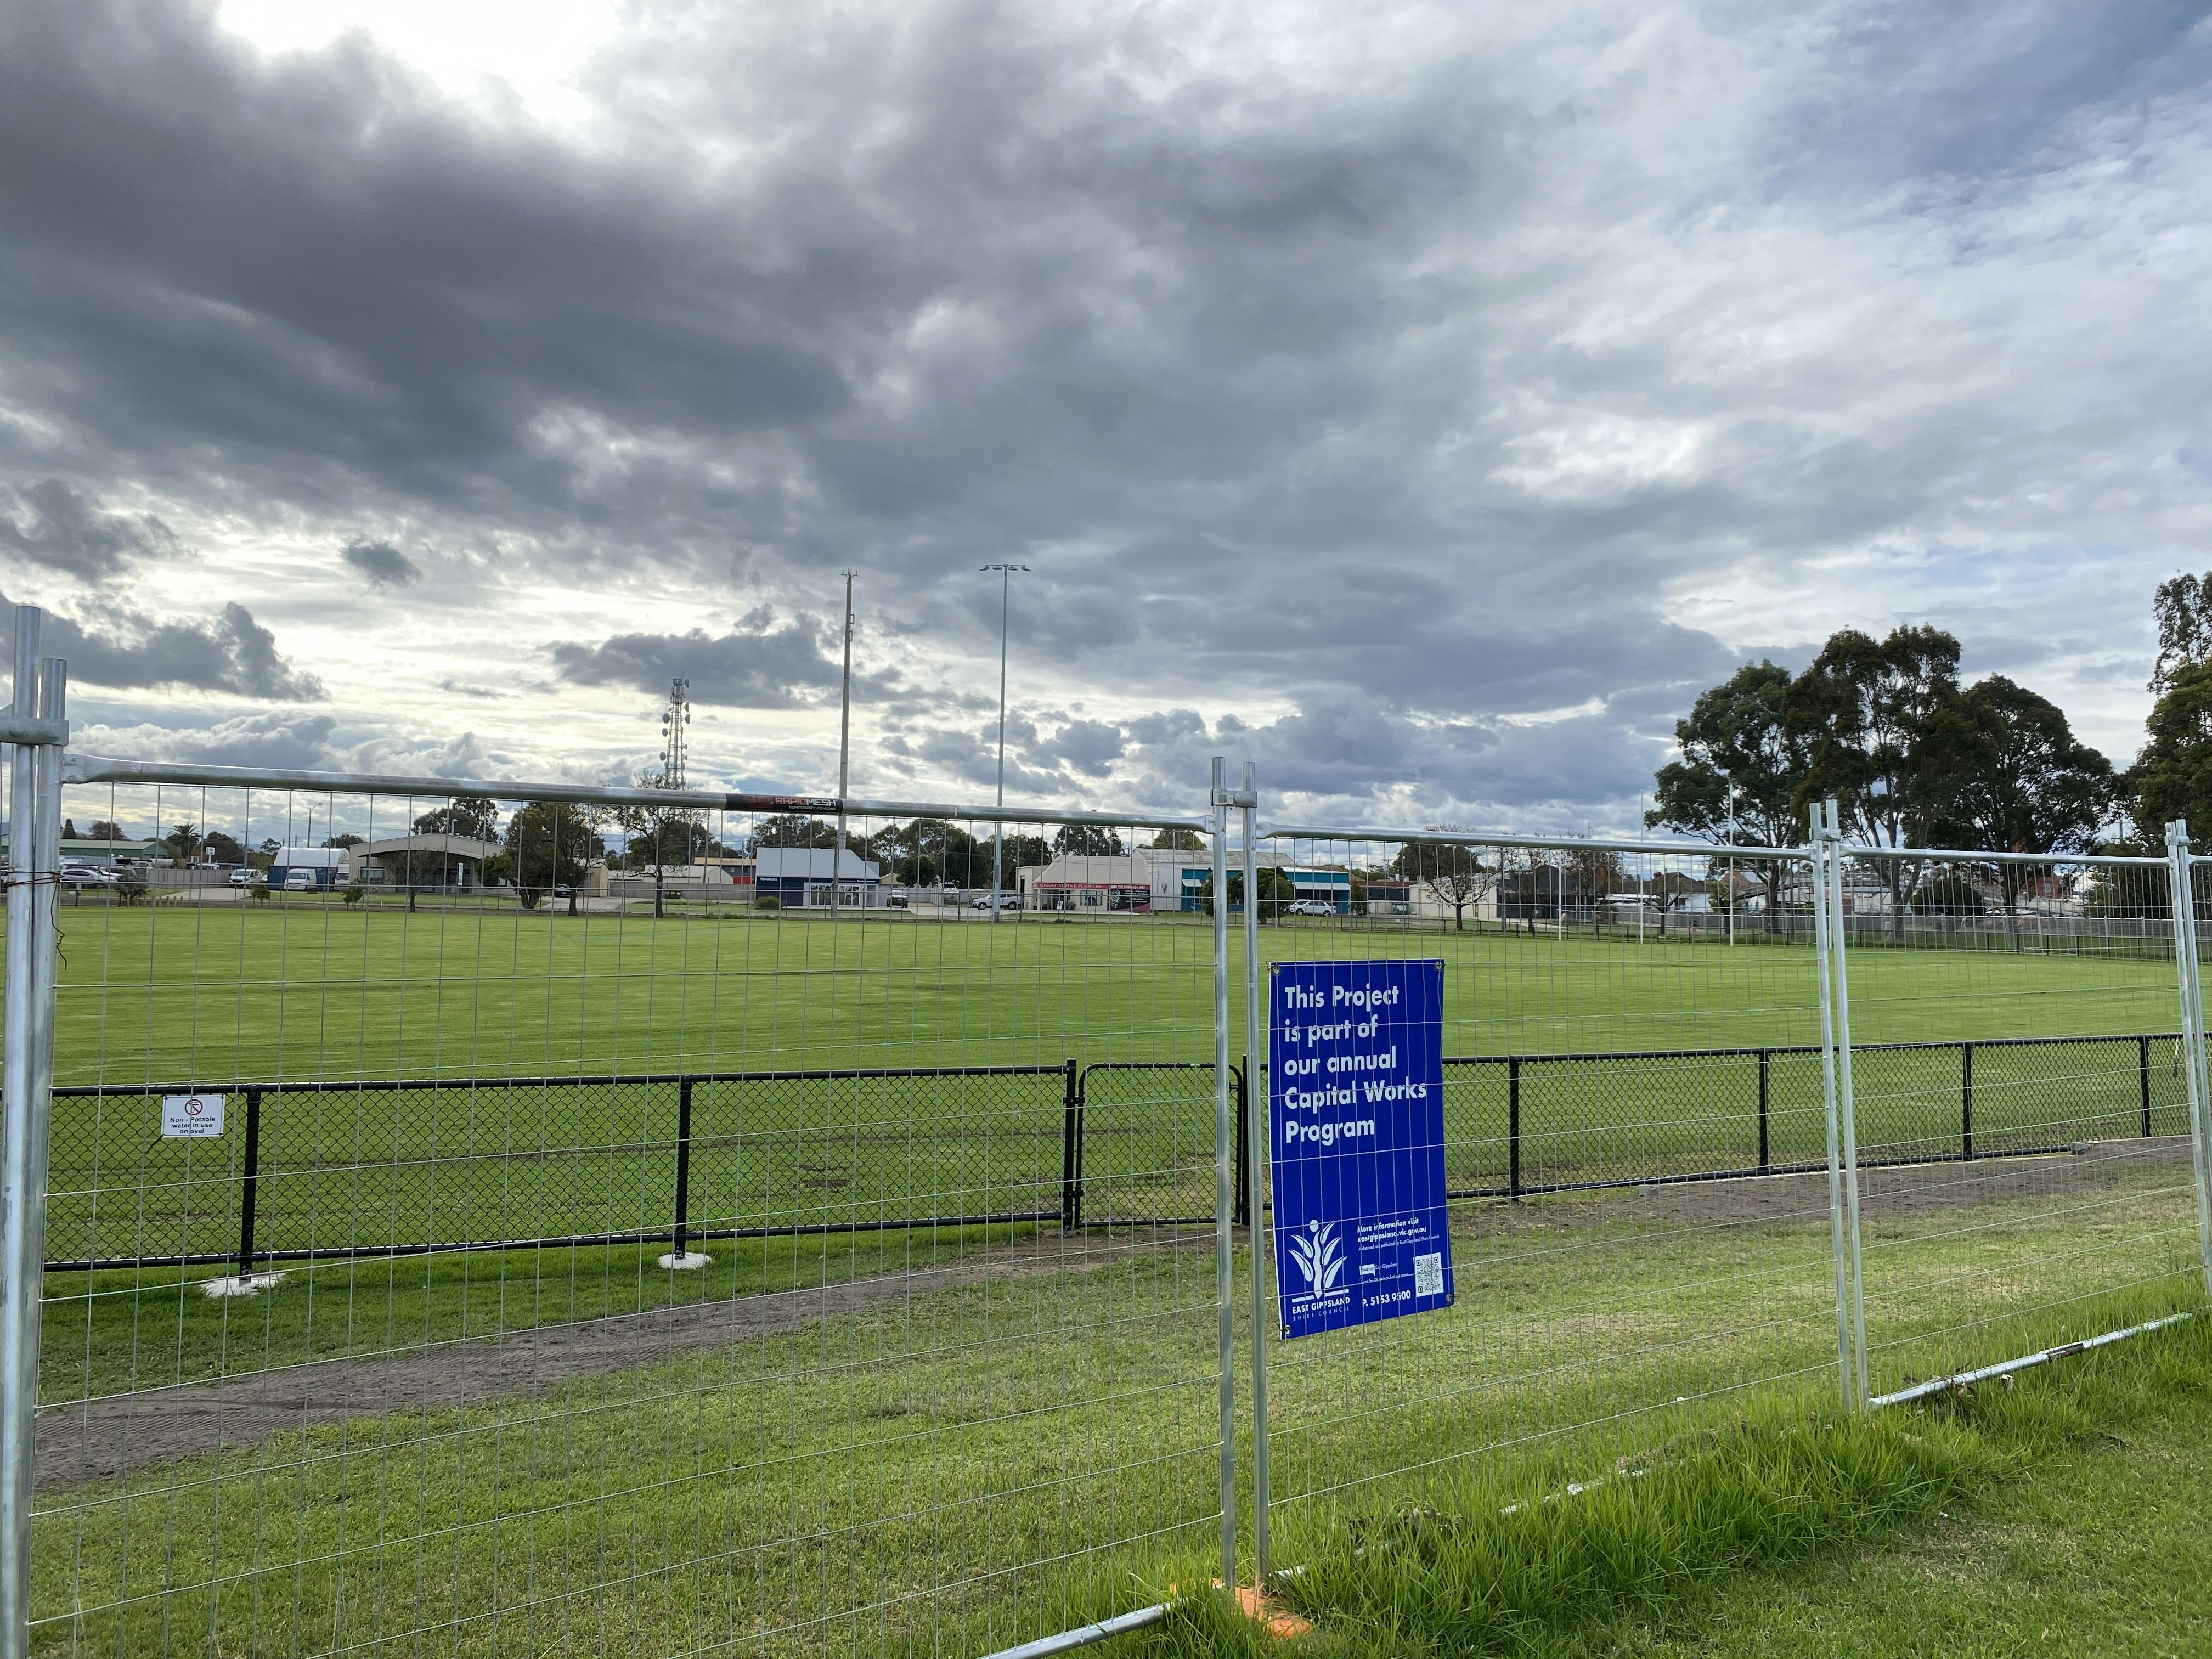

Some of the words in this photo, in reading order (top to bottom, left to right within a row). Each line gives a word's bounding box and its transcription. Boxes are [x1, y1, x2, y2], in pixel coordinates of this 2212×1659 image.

[775, 797, 836, 806] RAPIDMESH
[1285, 985, 1324, 1008] This
[1332, 983, 1399, 1012] Project
[1285, 1019, 1300, 1042] is
[1308, 1020, 1351, 1047] part
[1357, 1014, 1378, 1038] of
[1284, 1059, 1320, 1075] our
[1327, 1045, 1396, 1073] annual
[1284, 1080, 1356, 1114] Capital
[1363, 1076, 1427, 1103] Works
[1286, 1119, 1375, 1147] Program
[1292, 1304, 1309, 1314] EAST
[1311, 1296, 1350, 1311] GIPPSLAND
[1362, 1298, 1369, 1307] P.
[1370, 1294, 1390, 1306] 5153
[1391, 1290, 1411, 1302] 9500
[1293, 1312, 1314, 1322] SHIRE
[1318, 1306, 1350, 1316] COUNCIL
